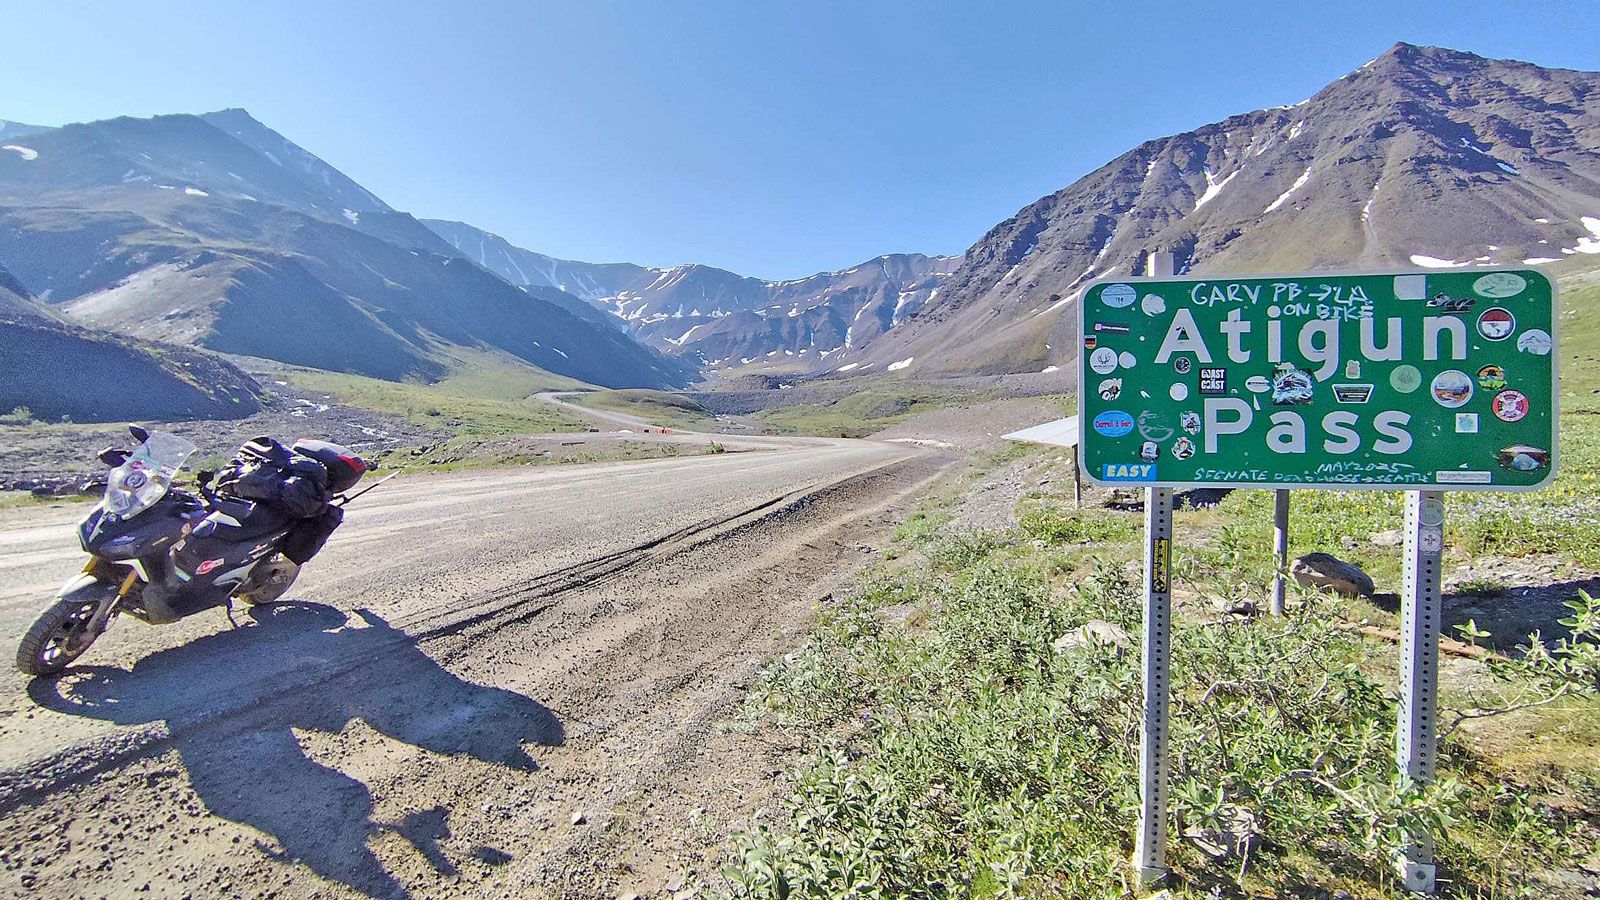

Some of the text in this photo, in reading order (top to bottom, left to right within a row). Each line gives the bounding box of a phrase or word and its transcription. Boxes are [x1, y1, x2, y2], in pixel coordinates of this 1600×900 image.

[1271, 282, 1302, 302] PB
[1283, 303, 1374, 322] ON BIKE
[1154, 306, 1468, 383] Atigun
[1204, 397, 1413, 455] Pass
[1106, 464, 1151, 478] EASY
